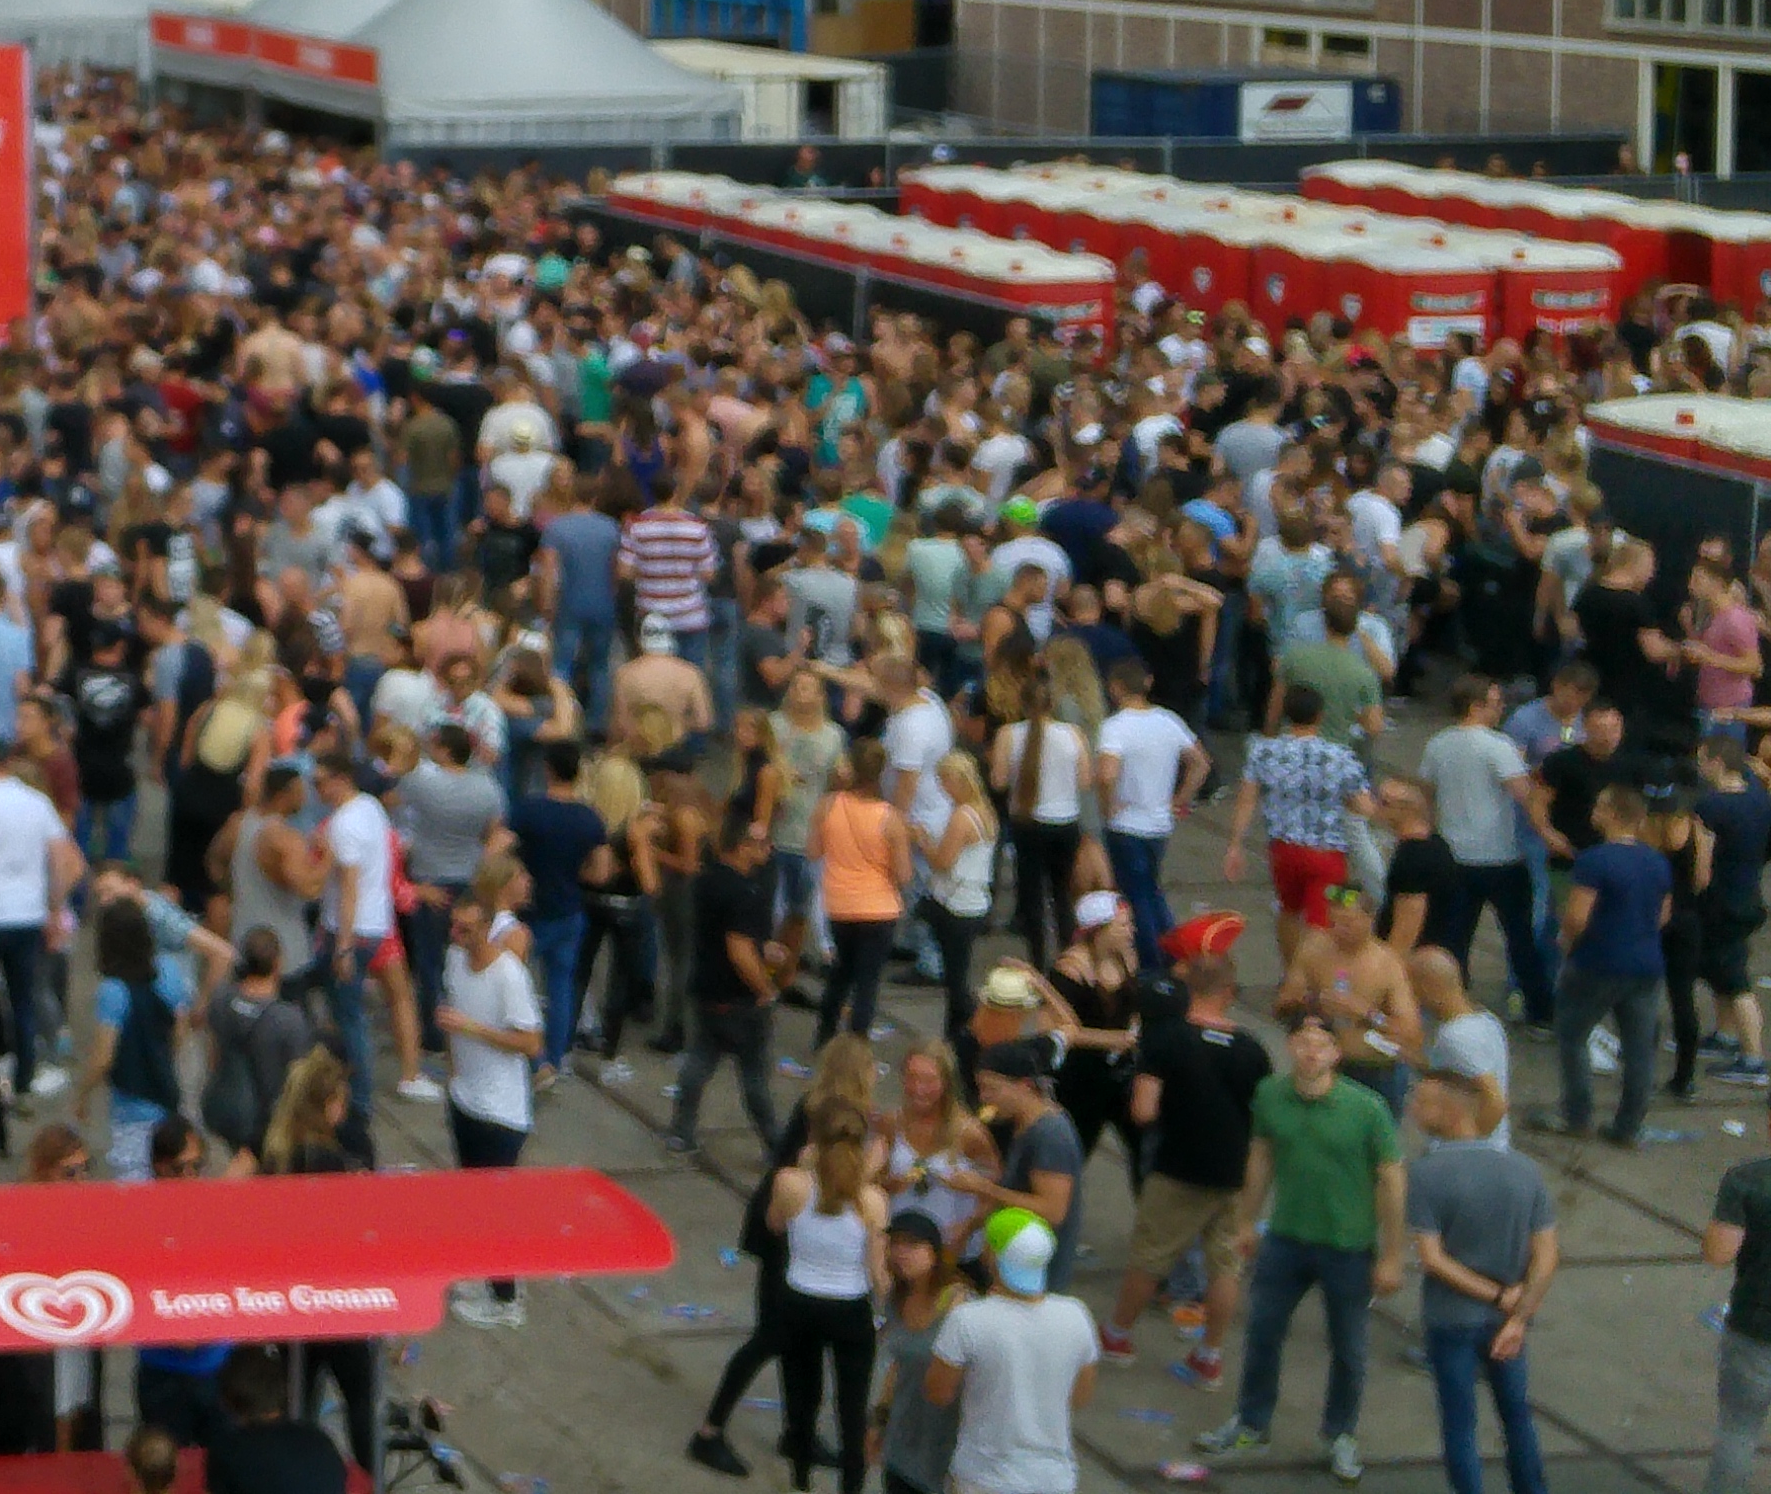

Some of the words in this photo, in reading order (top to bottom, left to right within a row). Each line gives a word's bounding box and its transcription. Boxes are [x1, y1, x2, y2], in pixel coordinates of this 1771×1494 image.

[150, 1289, 234, 1319] Love
[234, 1286, 288, 1316] Ice
[289, 1284, 400, 1313] Cream
